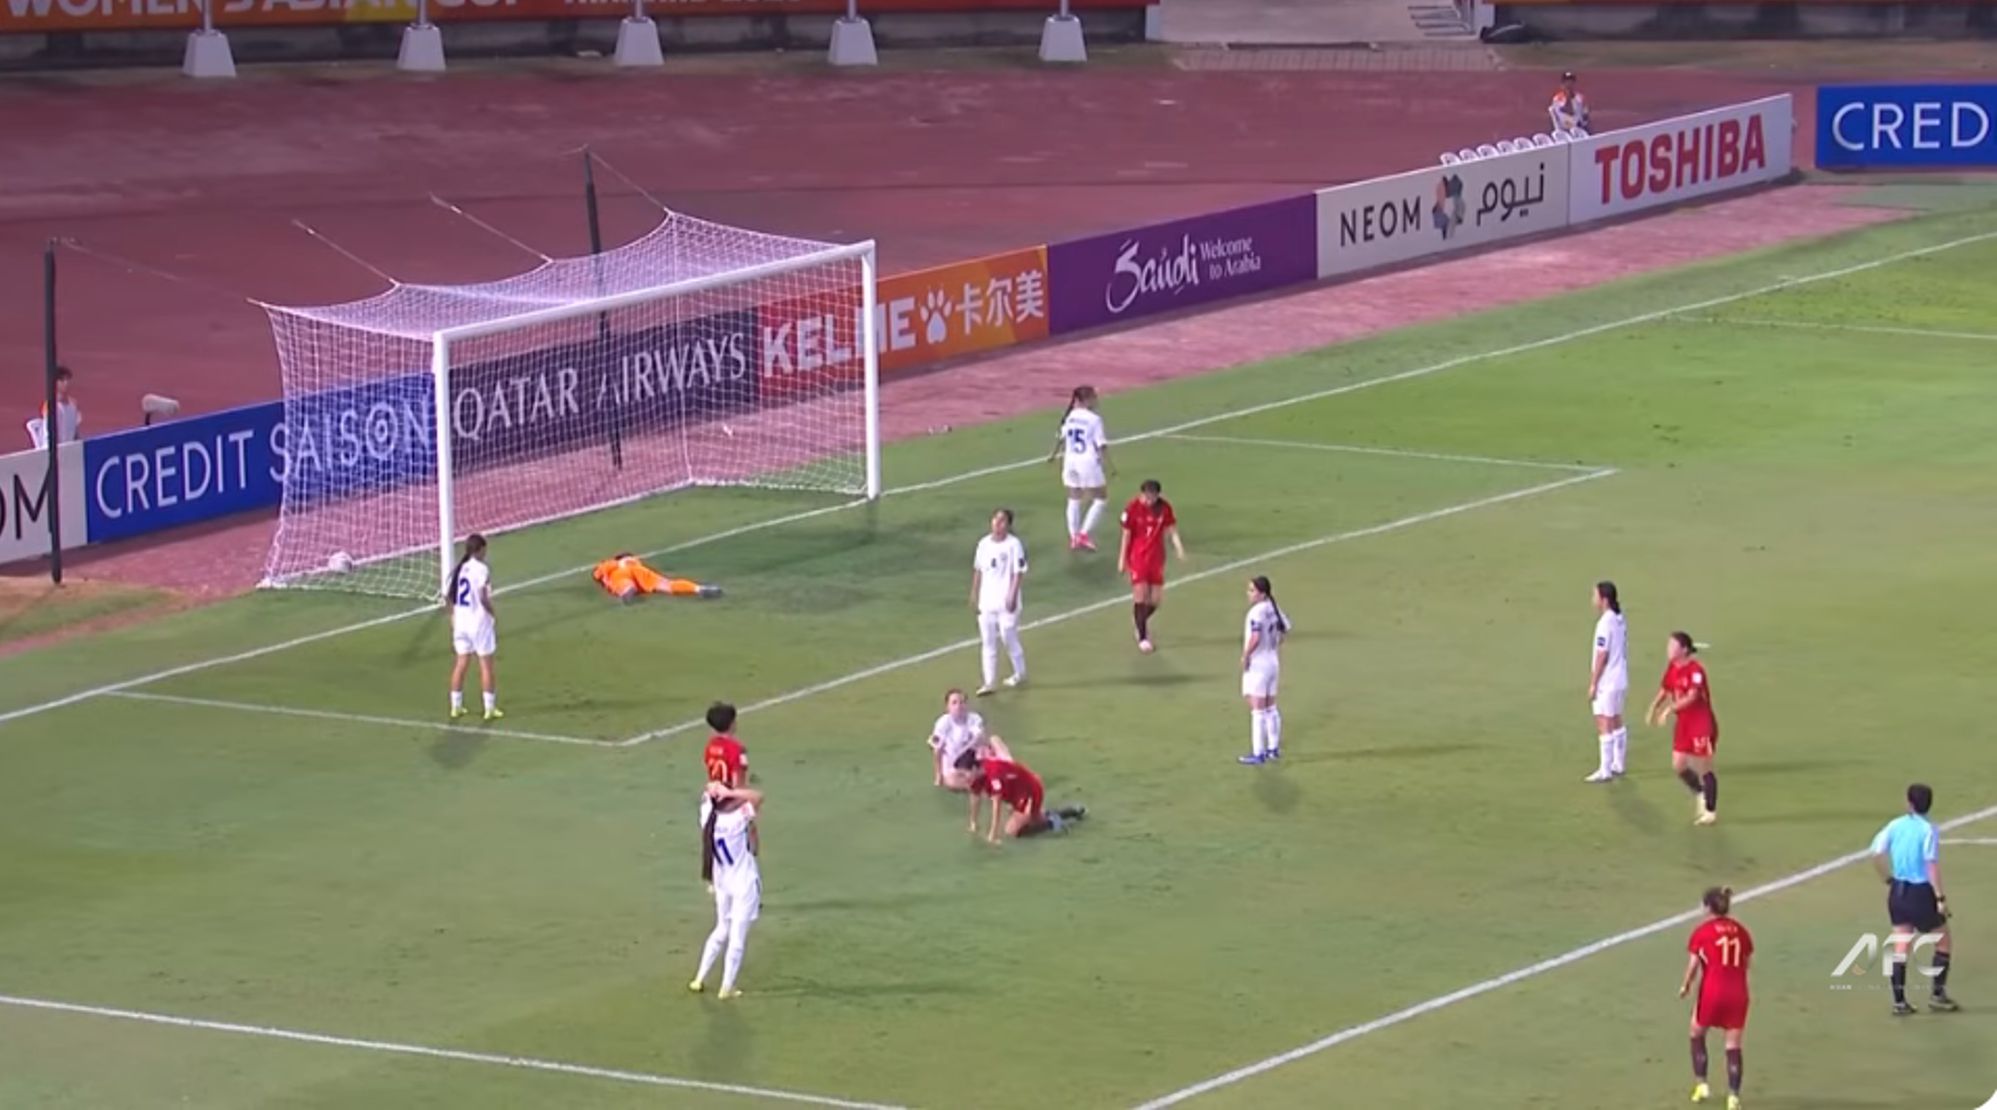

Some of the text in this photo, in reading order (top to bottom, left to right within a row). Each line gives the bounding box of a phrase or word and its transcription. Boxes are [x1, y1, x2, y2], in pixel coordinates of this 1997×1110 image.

[1595, 113, 1766, 204] TOSHIBA
[1831, 101, 1990, 152] CRED
[1340, 195, 1422, 247] NEOM
[1475, 161, 1545, 226] نيوم
[1106, 233, 1200, 314] Saudi
[1200, 237, 1253, 262] Welcome
[1208, 252, 1262, 280] to Arabia
[955, 269, 1045, 336] 卡尔美
[763, 296, 916, 378] KELME
[453, 332, 747, 441] QATAR AIRWAYS
[96, 393, 430, 518] CREDIT SAISON
[1715, 936, 1741, 967] 11
